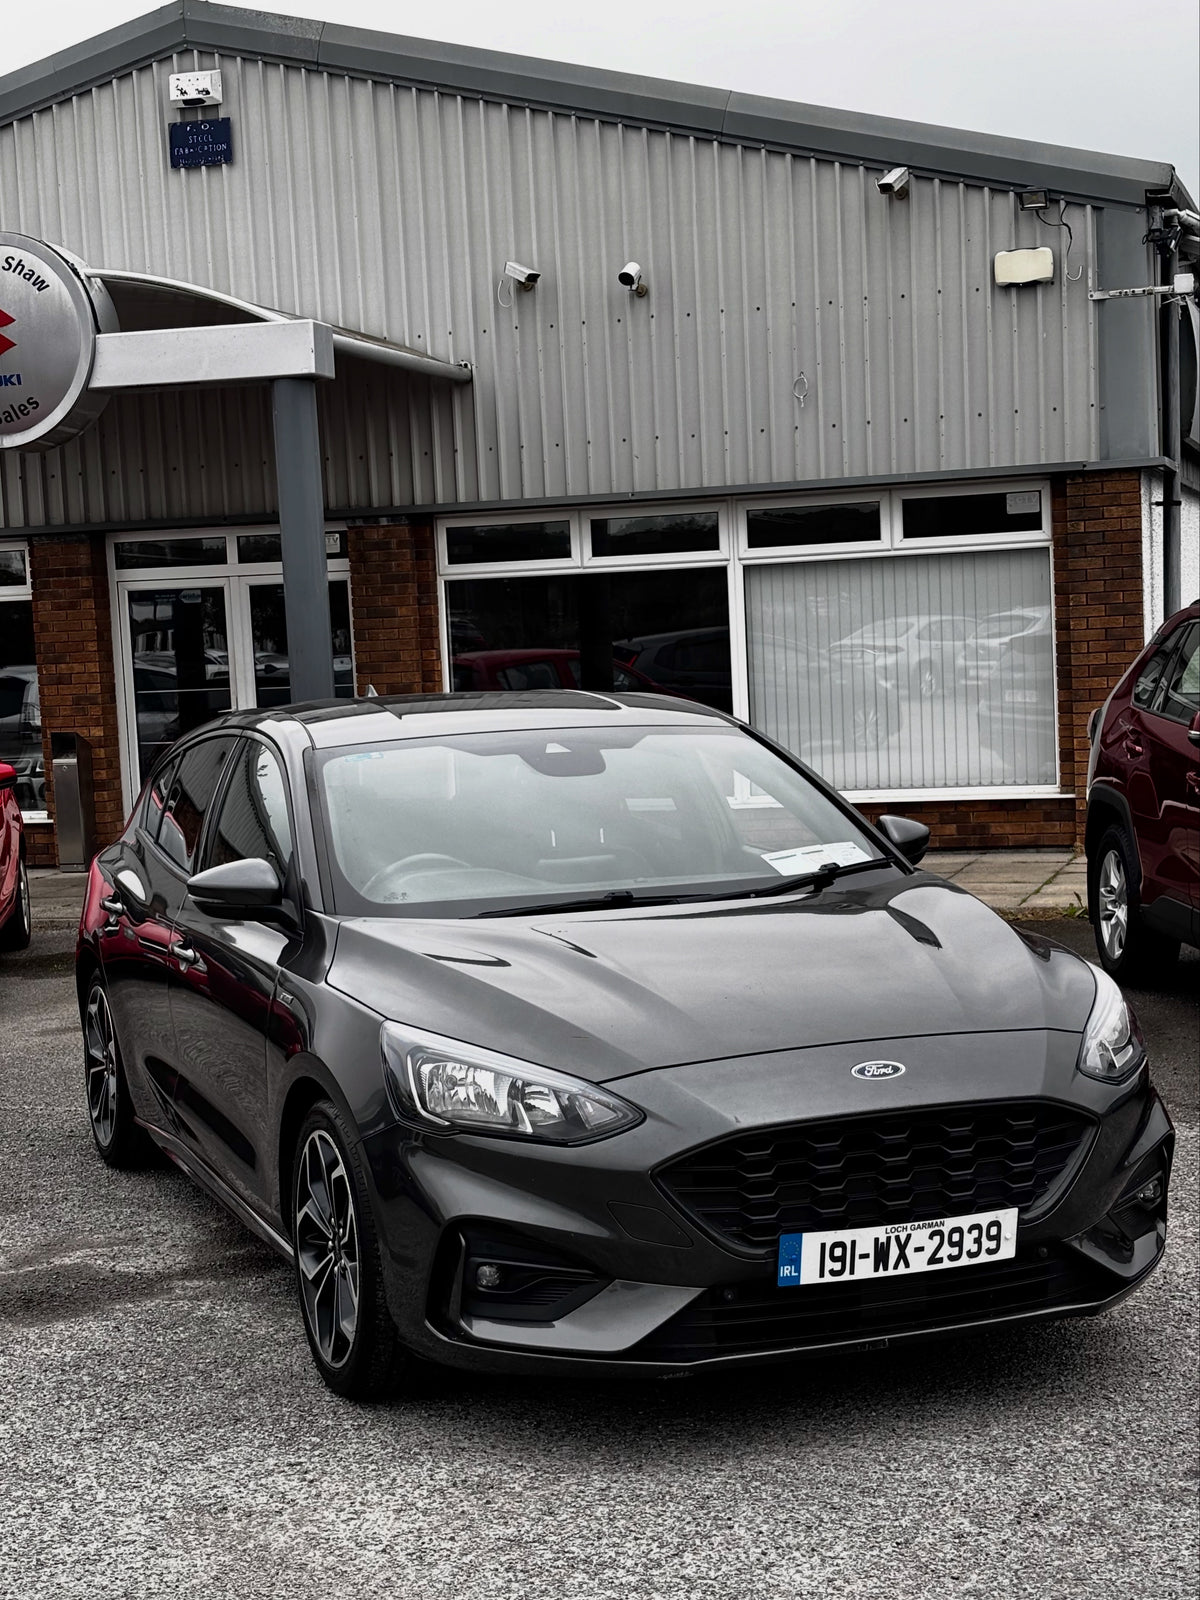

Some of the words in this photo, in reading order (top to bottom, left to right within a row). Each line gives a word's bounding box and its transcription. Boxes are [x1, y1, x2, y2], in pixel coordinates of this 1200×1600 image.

[1, 256, 50, 292] Shaw
[864, 1064, 894, 1076] Ford
[885, 1225, 908, 1235] LOCH
[910, 1220, 945, 1232] GARMAN
[818, 1220, 1002, 1278] 191-WX-2939
[780, 1266, 798, 1277] IRL
